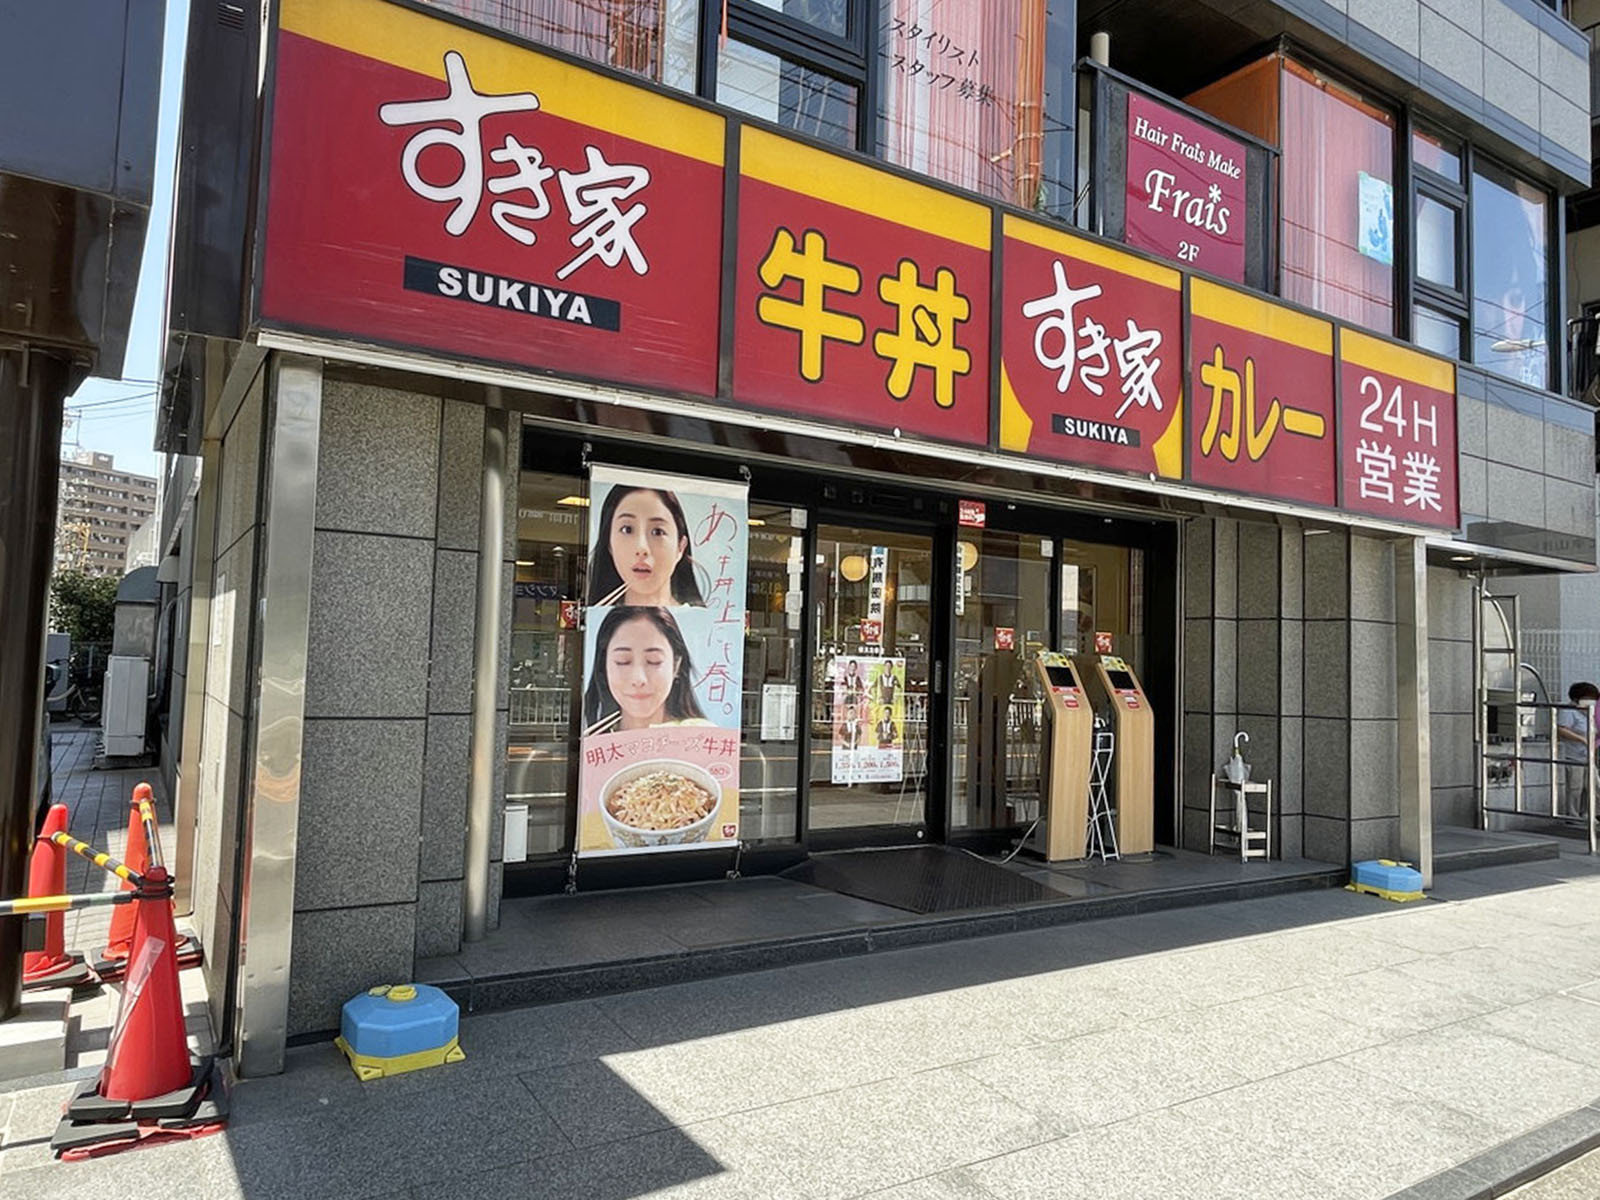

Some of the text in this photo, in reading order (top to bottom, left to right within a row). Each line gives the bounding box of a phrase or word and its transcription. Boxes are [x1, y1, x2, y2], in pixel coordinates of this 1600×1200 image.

[890, 17, 979, 67] スタイリスト
[379, 50, 651, 281] すき家
[1134, 116, 1241, 179] Hair Frais Make
[1145, 168, 1230, 235] Frais
[1177, 241, 1200, 262] 2F
[437, 266, 592, 325] SUKIYA
[757, 227, 971, 409] 牛丼
[1023, 260, 1163, 419] すき家
[1064, 417, 1129, 445] SUKIYA
[1200, 345, 1326, 463] カレー
[1359, 376, 1438, 447] 24H
[1356, 440, 1443, 513] 営業
